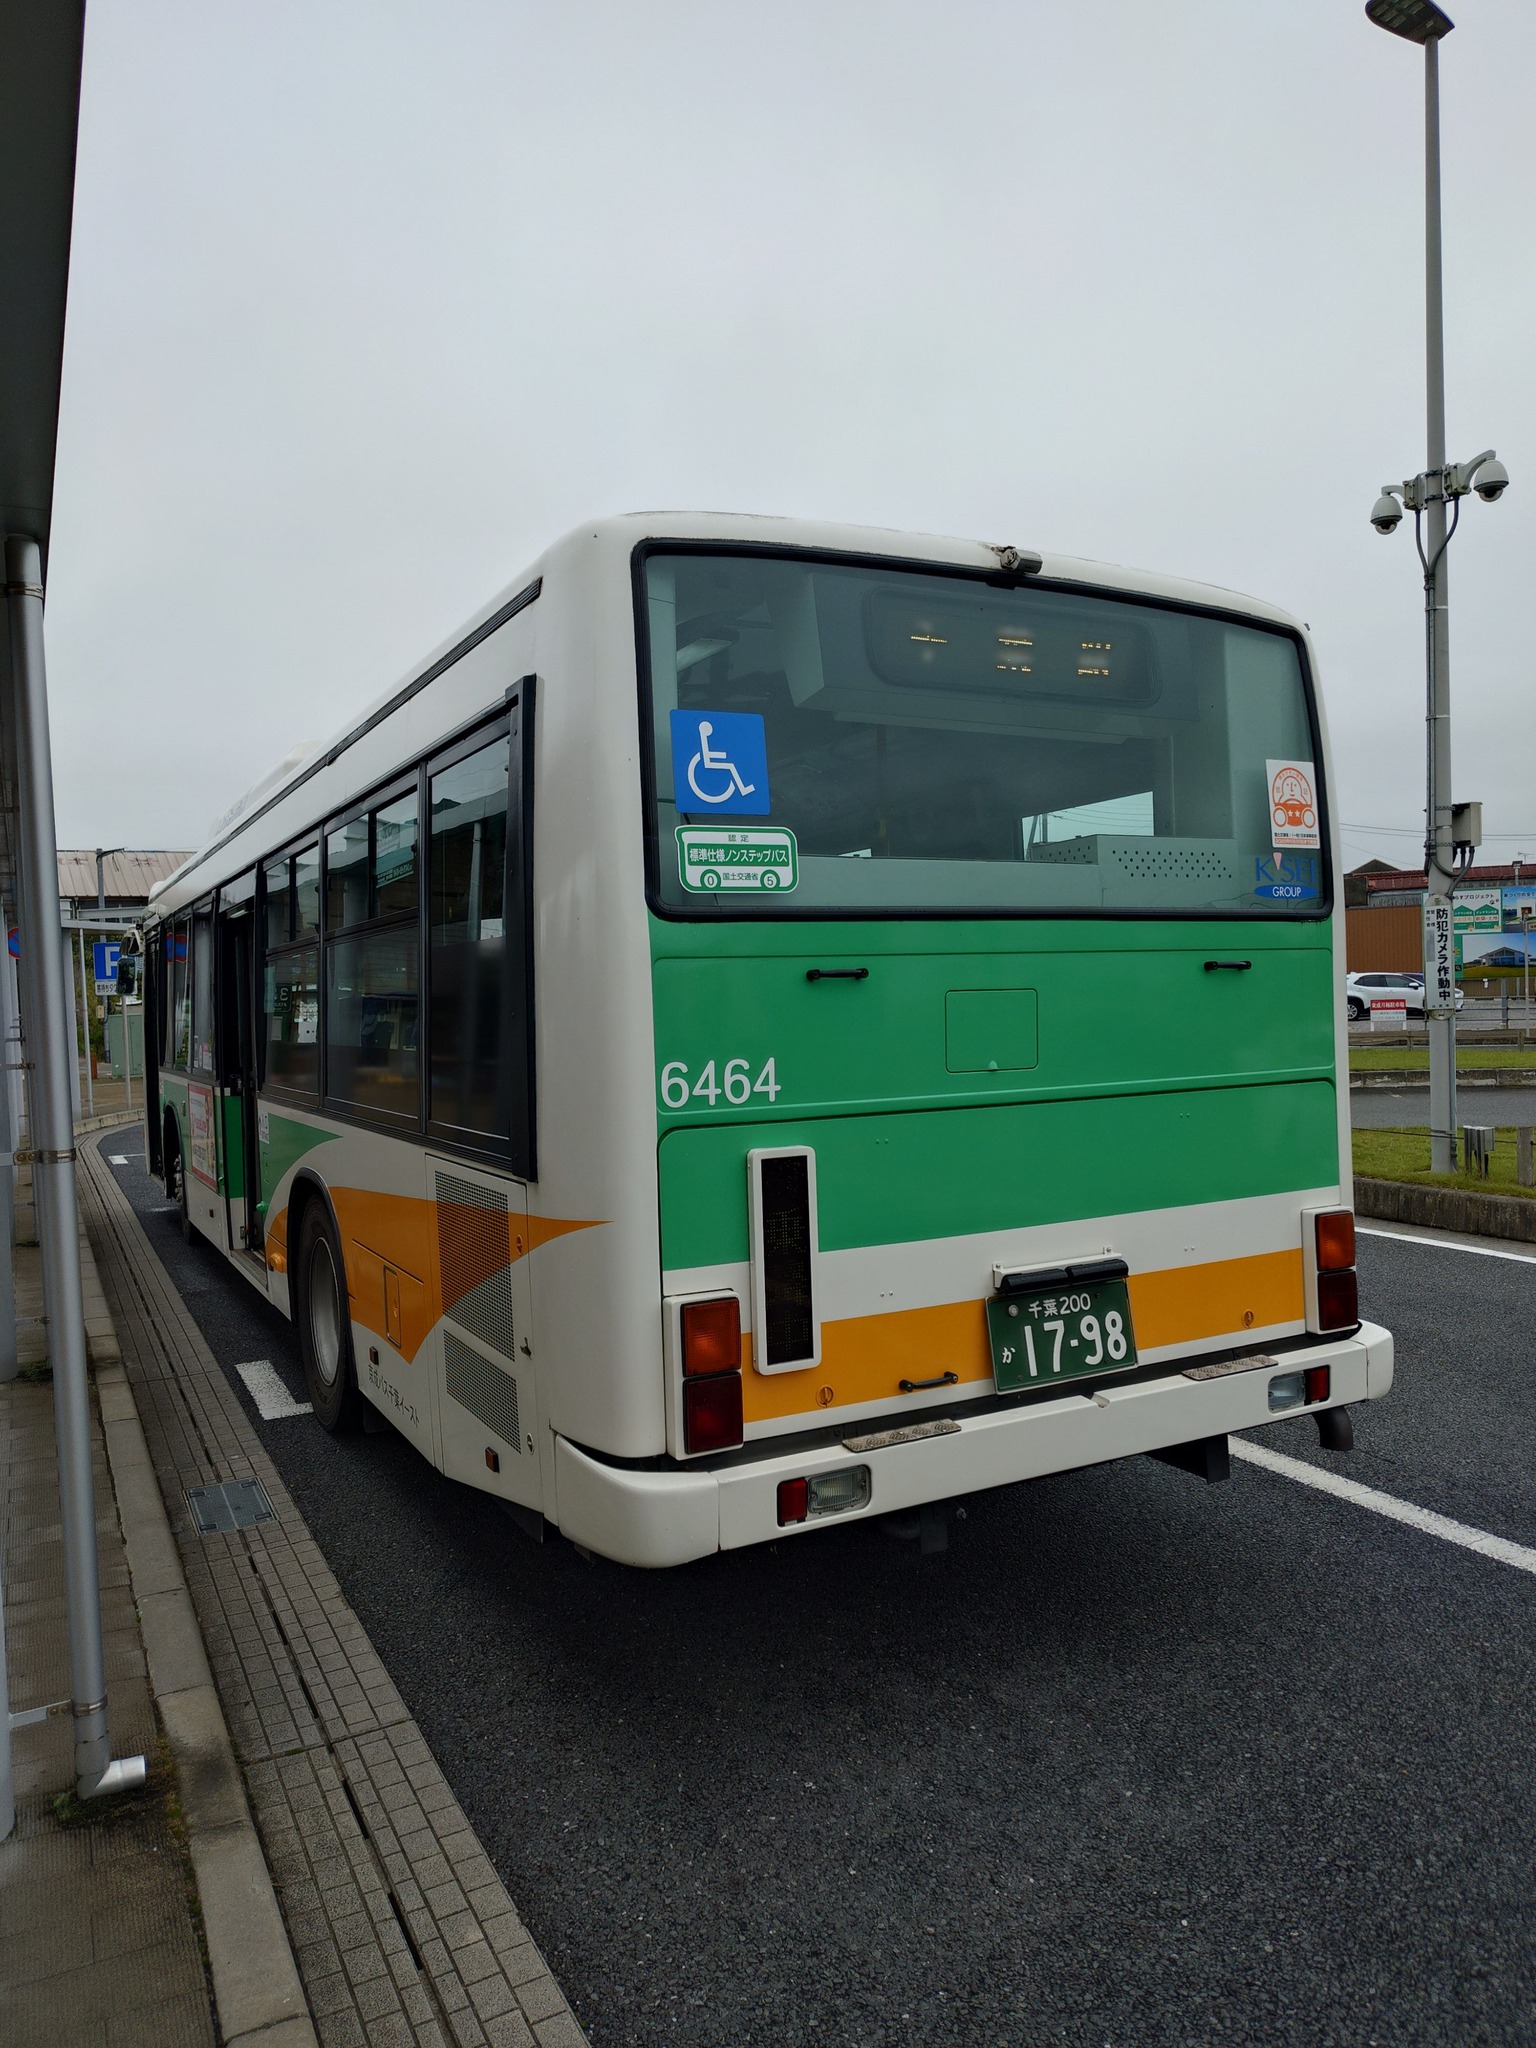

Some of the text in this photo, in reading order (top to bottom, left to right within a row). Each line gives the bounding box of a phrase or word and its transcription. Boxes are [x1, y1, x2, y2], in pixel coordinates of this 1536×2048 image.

[728, 834, 749, 843] 認定
[689, 848, 788, 863] 標準仕様ノンステップバス
[707, 876, 774, 888] 0 5
[722, 872, 759, 882] 国土交通省
[1272, 886, 1302, 898] GROUP
[105, 946, 127, 977] P
[1436, 908, 1451, 1001] 防犯カメラ作動中
[661, 1057, 781, 1108] 6464
[1002, 1310, 1128, 1377] か 17-98
